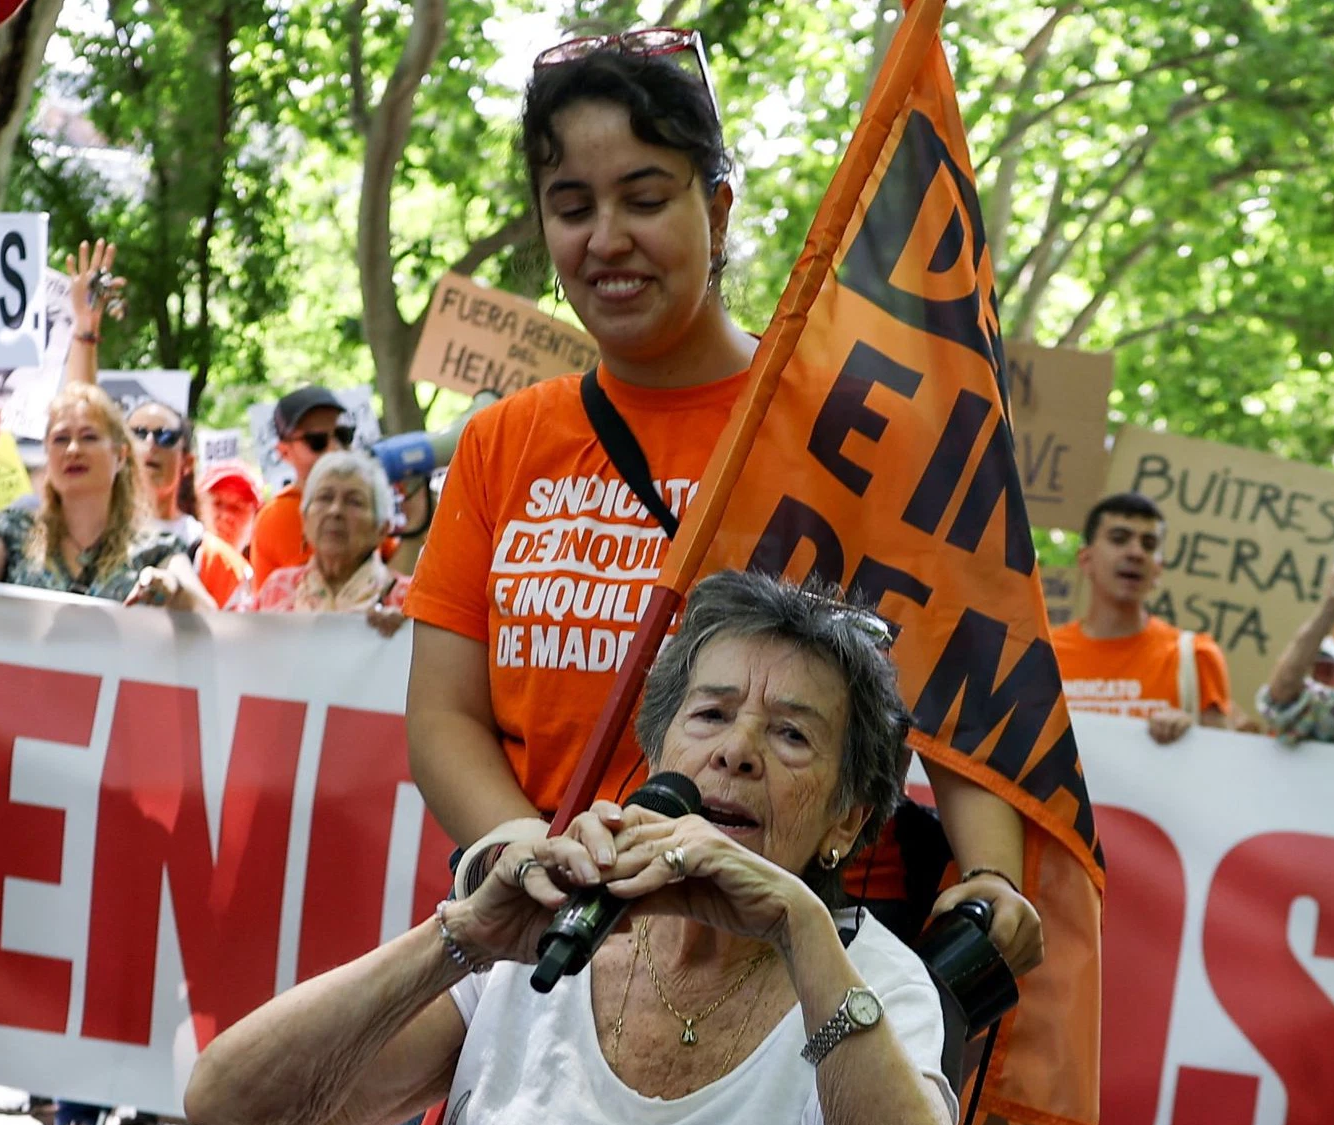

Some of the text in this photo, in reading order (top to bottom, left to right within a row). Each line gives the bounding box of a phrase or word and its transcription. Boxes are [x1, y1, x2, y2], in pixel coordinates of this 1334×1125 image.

[439, 287, 516, 336] FUERA
[507, 343, 540, 368] DEL
[525, 474, 700, 521] SINDICT
[505, 529, 554, 563] DE
[1162, 531, 1327, 602] UERA!
[494, 577, 515, 618] E
[1144, 590, 1271, 657] ASTA
[496, 625, 525, 669] DE
